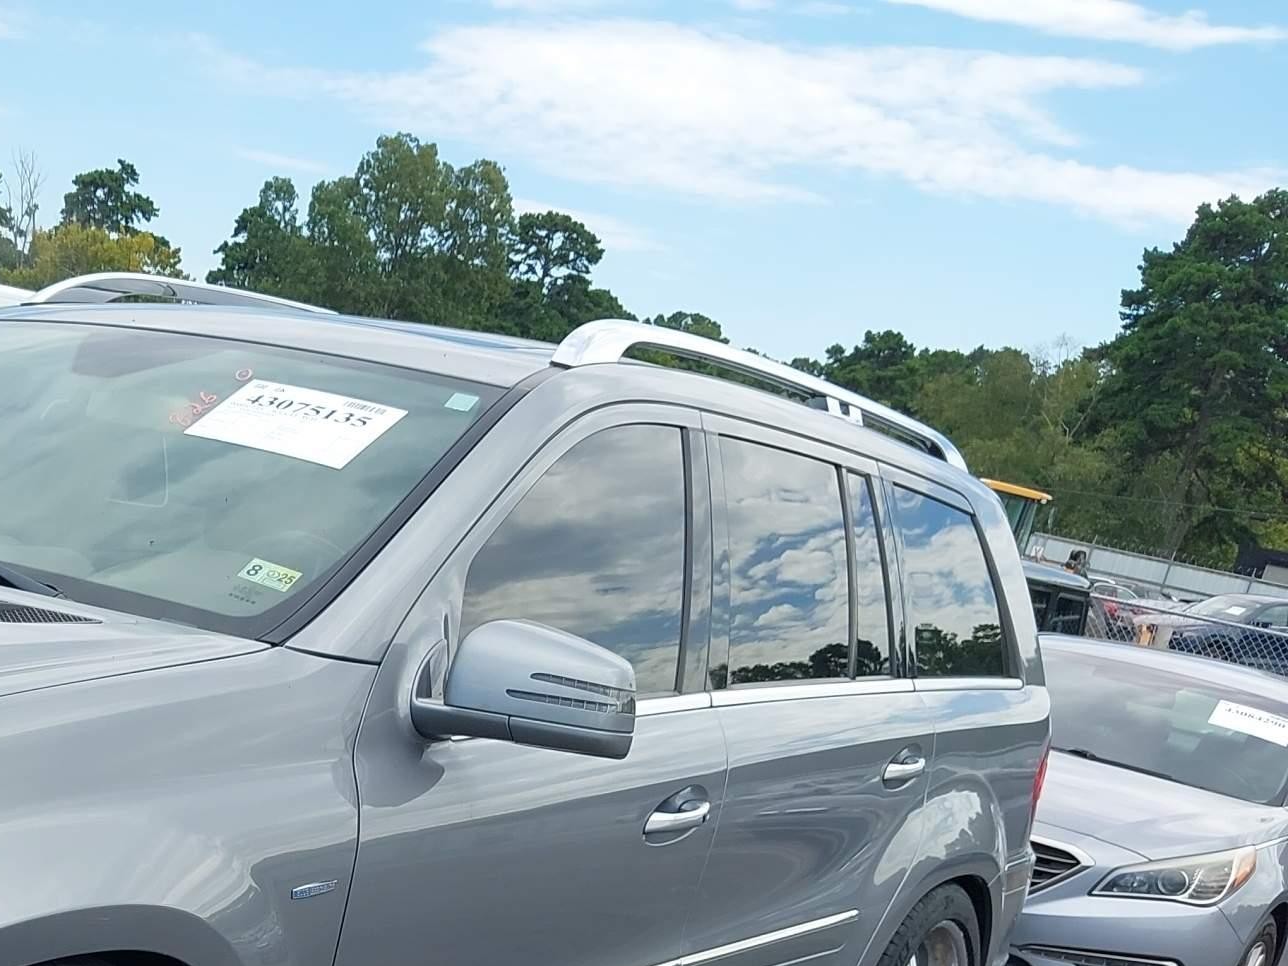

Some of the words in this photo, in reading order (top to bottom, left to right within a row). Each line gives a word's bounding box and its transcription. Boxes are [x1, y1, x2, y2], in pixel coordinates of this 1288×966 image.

[246, 394, 373, 428] 43075135
[246, 564, 263, 577] 8
[277, 573, 296, 585] 25
